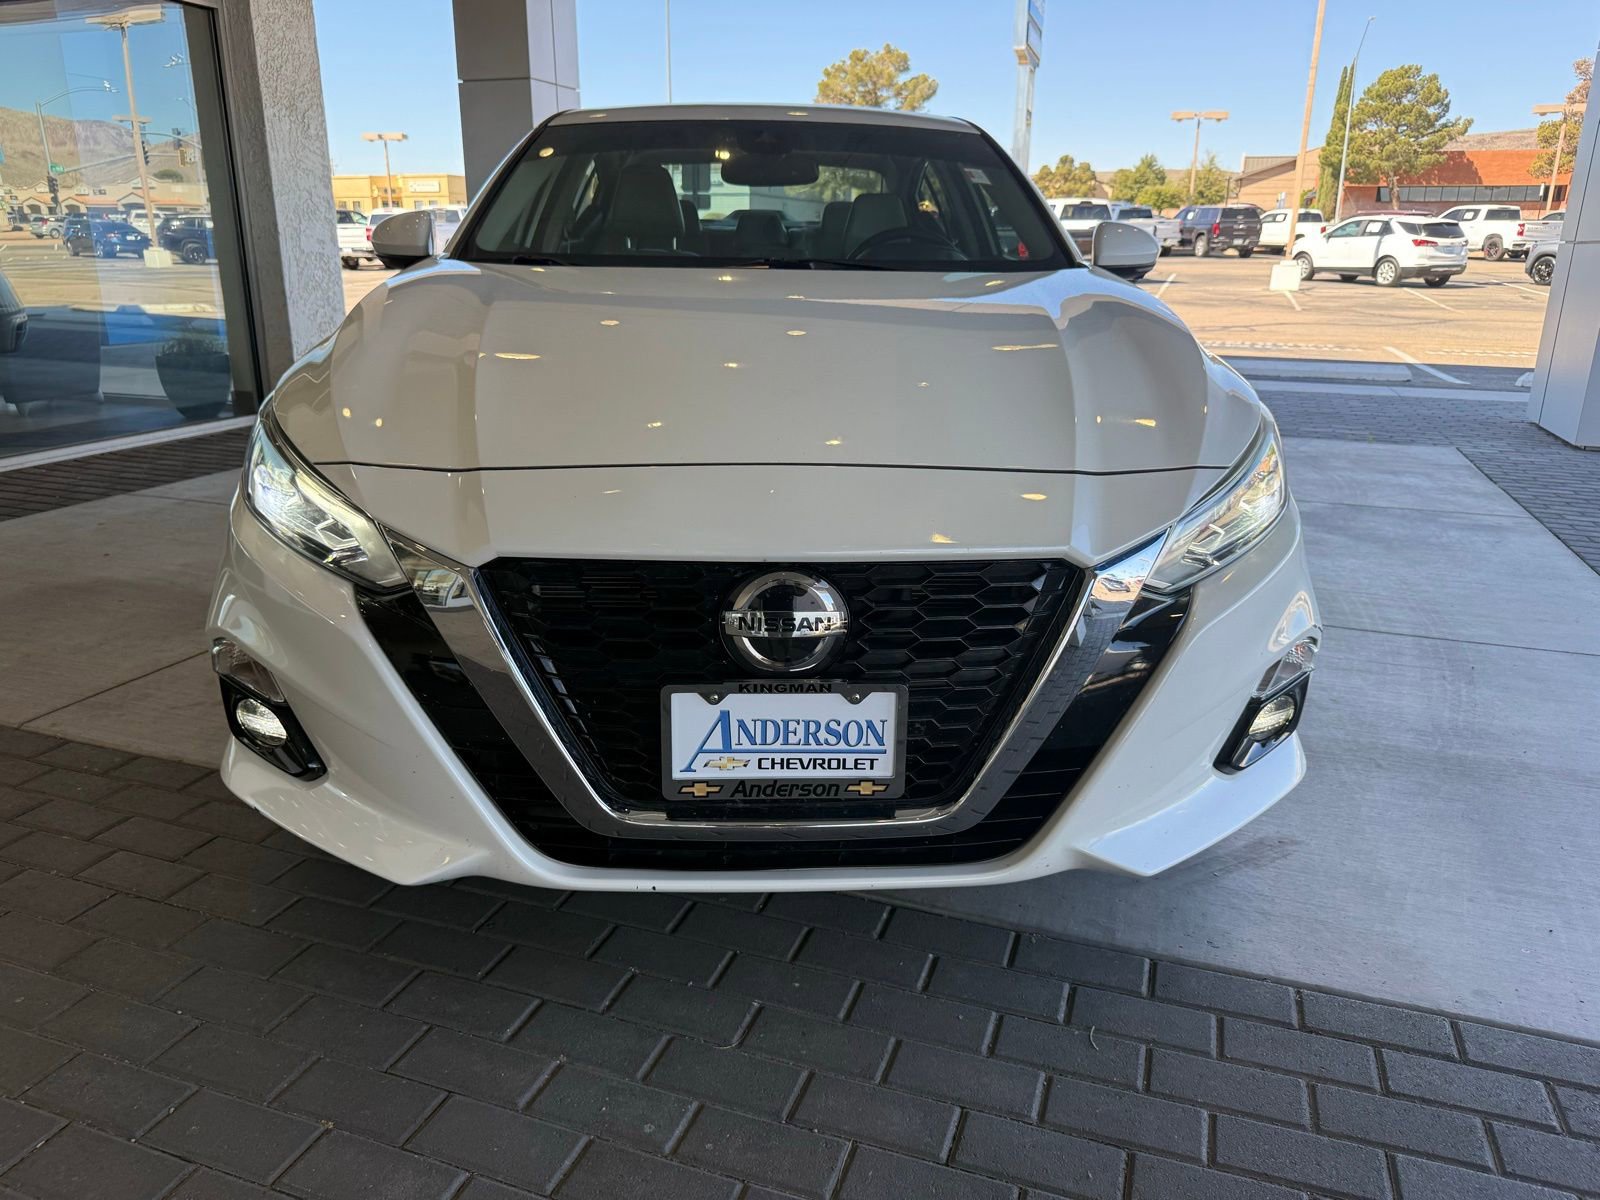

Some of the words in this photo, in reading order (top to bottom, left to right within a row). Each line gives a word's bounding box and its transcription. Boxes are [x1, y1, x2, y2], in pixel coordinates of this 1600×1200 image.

[737, 616, 832, 632] NISSAN
[738, 683, 832, 694] KINGMAN
[680, 709, 888, 773] ANDERSON
[757, 757, 879, 771] CHEVROLET
[730, 780, 840, 798] Anderson
